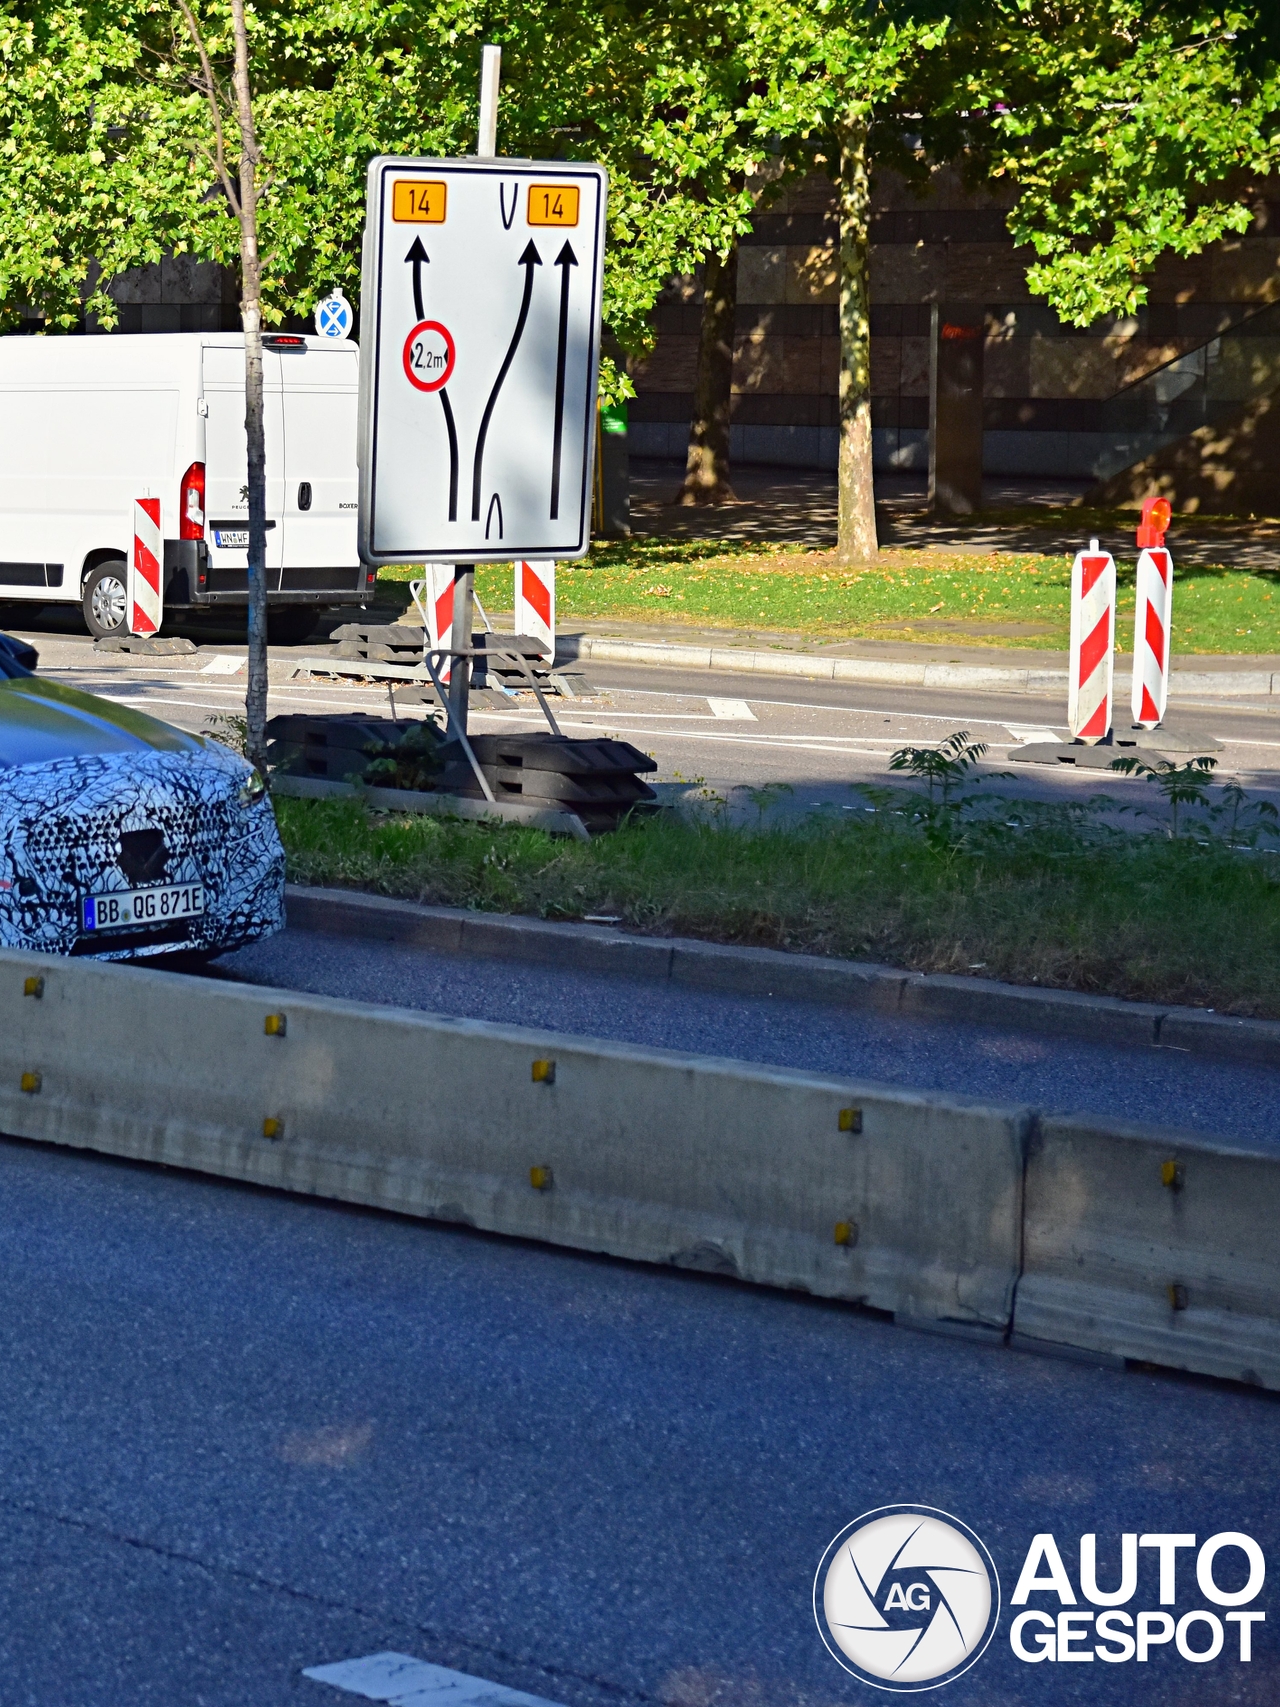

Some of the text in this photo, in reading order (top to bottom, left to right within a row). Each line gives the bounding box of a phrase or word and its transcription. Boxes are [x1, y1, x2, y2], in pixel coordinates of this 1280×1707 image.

[409, 189, 430, 215] 14
[543, 193, 563, 218] 14
[415, 342, 442, 369] 2,2m
[221, 532, 233, 543] WN
[97, 887, 202, 925] BB QG 871E
